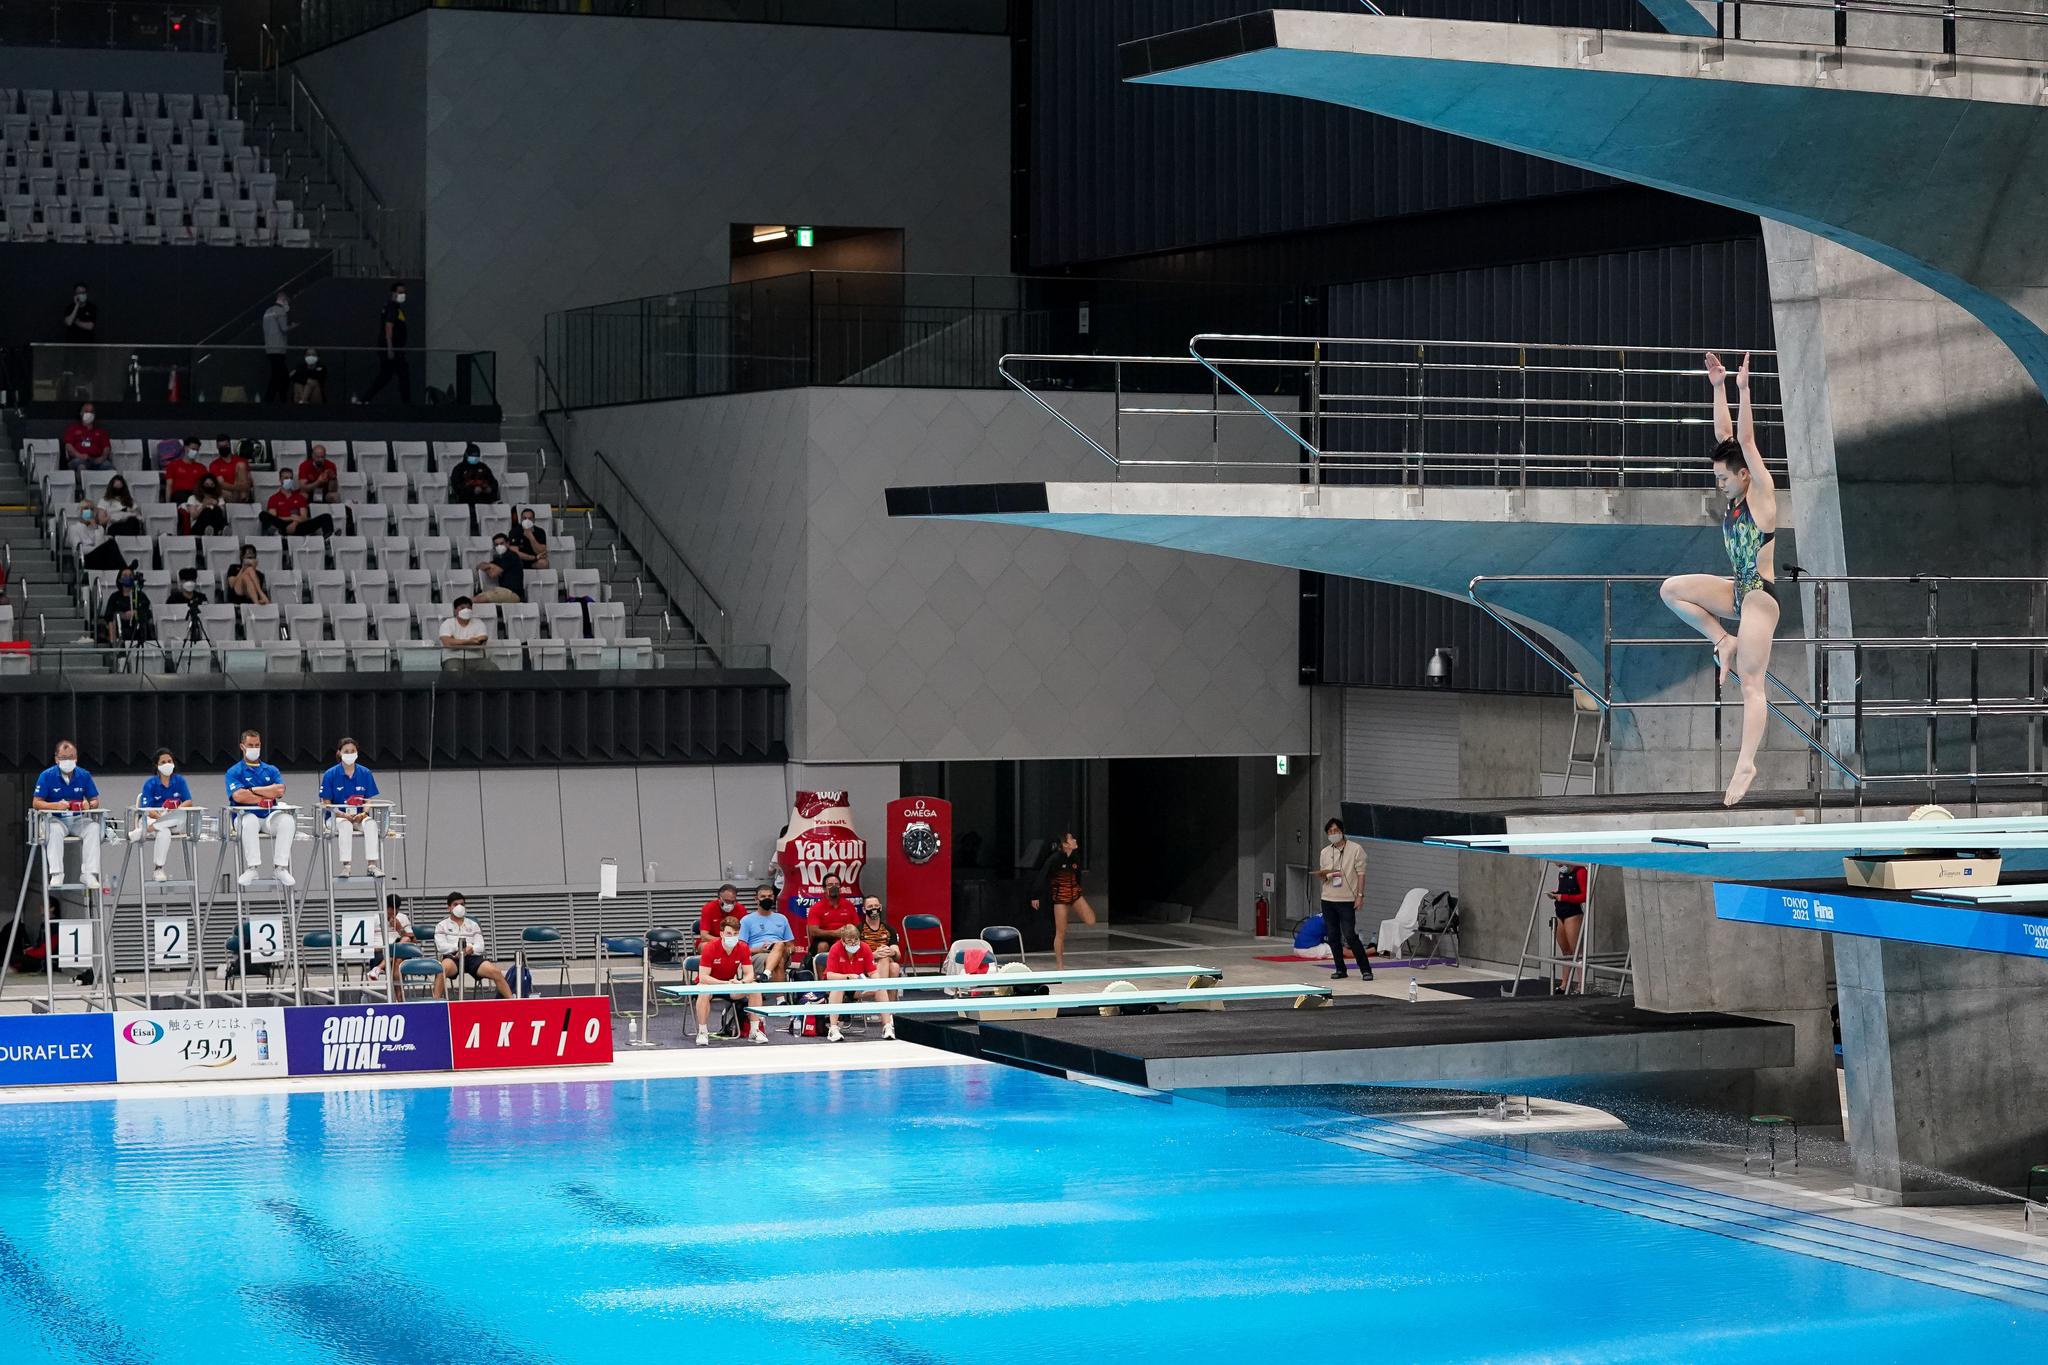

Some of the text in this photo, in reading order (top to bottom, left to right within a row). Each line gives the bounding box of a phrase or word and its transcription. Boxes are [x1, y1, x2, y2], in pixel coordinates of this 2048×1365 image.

[903, 809, 938, 818] OMEGA
[795, 839, 864, 860] Yakult
[795, 860, 862, 885] 1000
[1782, 896, 1809, 910] TOKYO
[1792, 909, 1810, 921] 2021
[69, 927, 80, 963] 1
[163, 924, 182, 960] 2
[258, 923, 277, 957] 3
[349, 919, 369, 954] 4
[132, 1028, 155, 1037] Eisai
[322, 1007, 406, 1044] amino
[464, 1007, 601, 1057] AKTIO
[0, 1043, 94, 1062] DURAFLEX
[178, 1038, 233, 1061] イータック
[323, 1042, 382, 1072] VITAL
